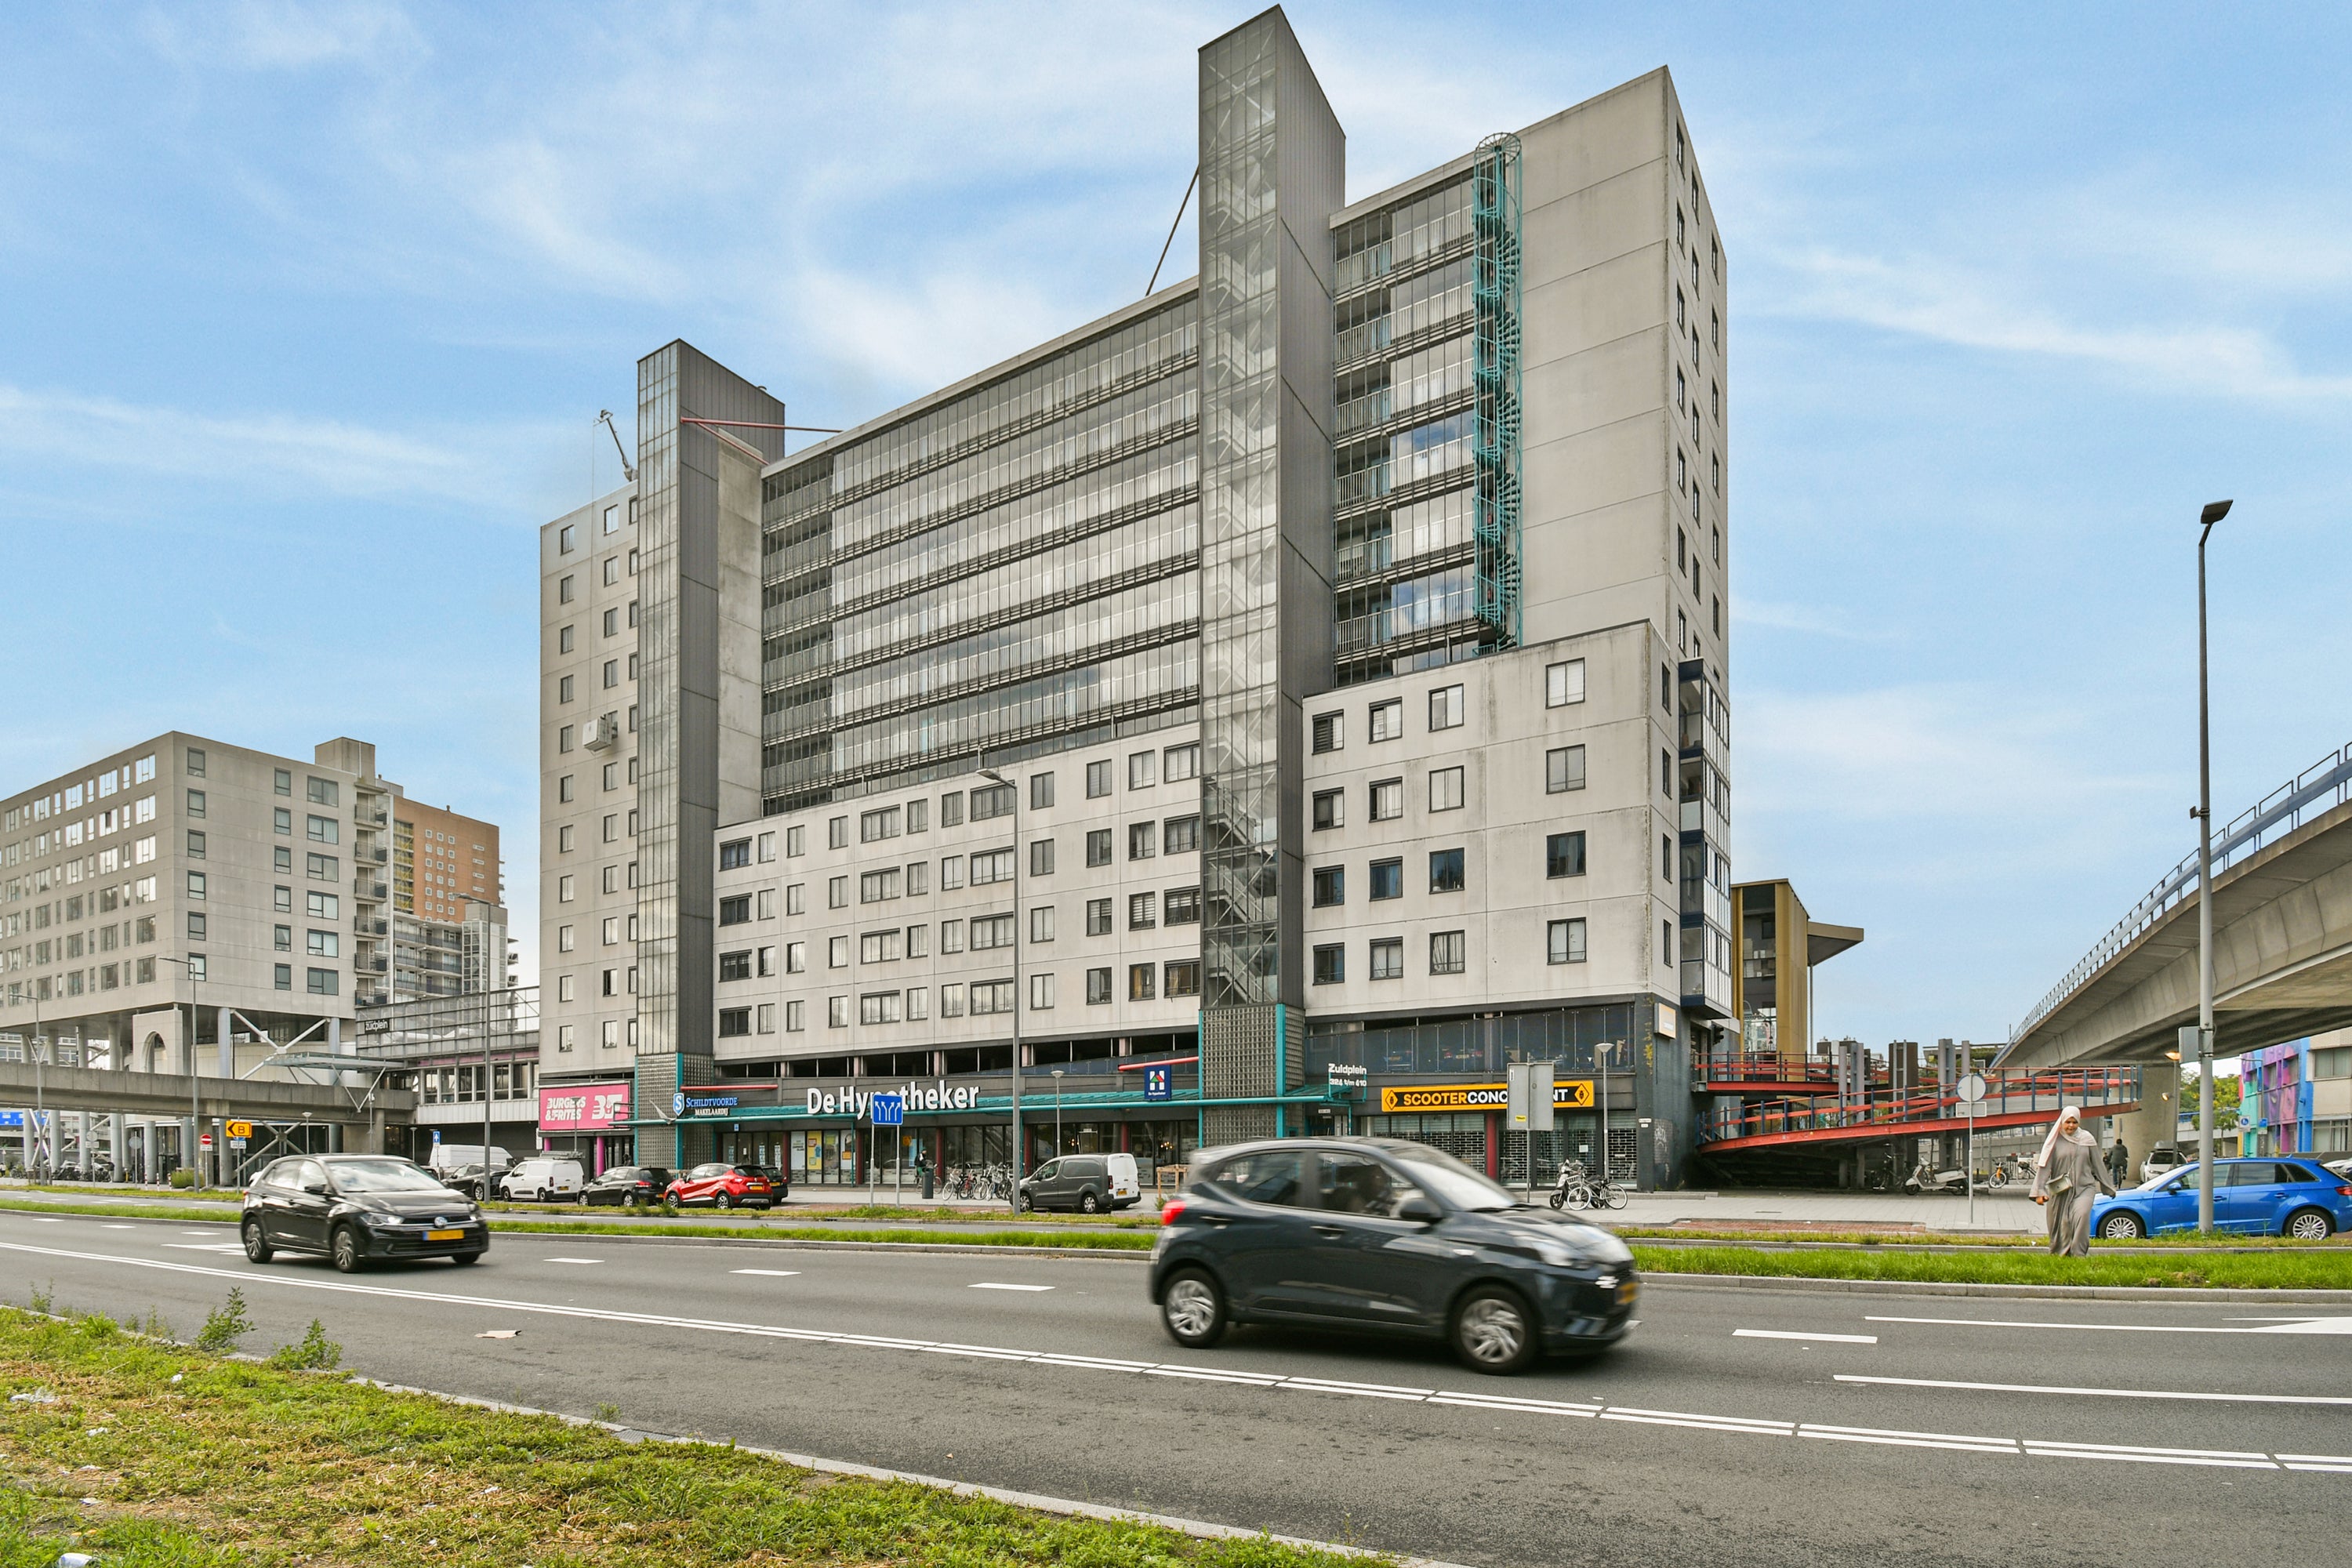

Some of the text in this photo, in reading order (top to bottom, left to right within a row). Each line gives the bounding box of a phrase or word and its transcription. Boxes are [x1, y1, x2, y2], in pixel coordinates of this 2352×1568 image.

[1330, 1078, 1343, 1087] 324
[807, 1080, 980, 1121] De Hytheker
